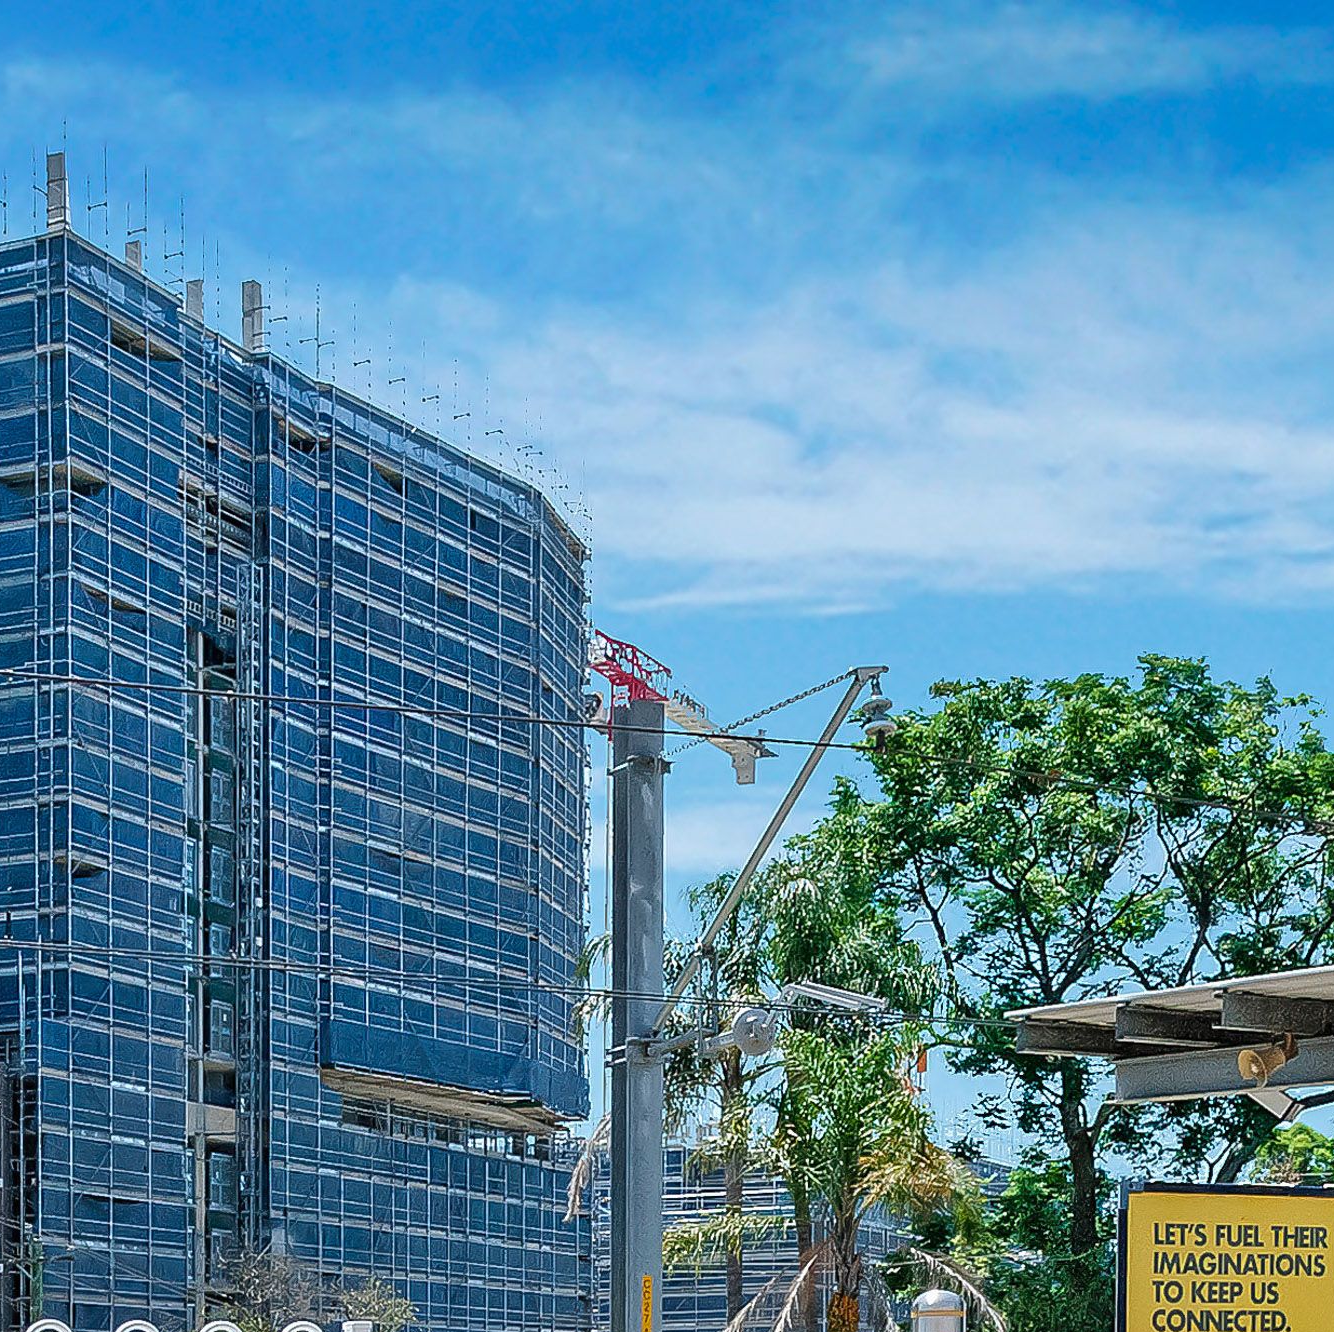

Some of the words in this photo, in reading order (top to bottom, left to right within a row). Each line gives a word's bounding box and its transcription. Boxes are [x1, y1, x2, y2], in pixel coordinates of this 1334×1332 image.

[1153, 1222, 1207, 1247] LET'S
[1215, 1224, 1265, 1248] FUEL
[1271, 1225, 1328, 1249] THEIR
[1153, 1251, 1326, 1277] IMAGINATIONS
[1152, 1280, 1184, 1304] TO
[1191, 1281, 1244, 1304] KEEP
[1250, 1281, 1280, 1305] US
[1152, 1308, 1292, 1332] CONNECTED.
